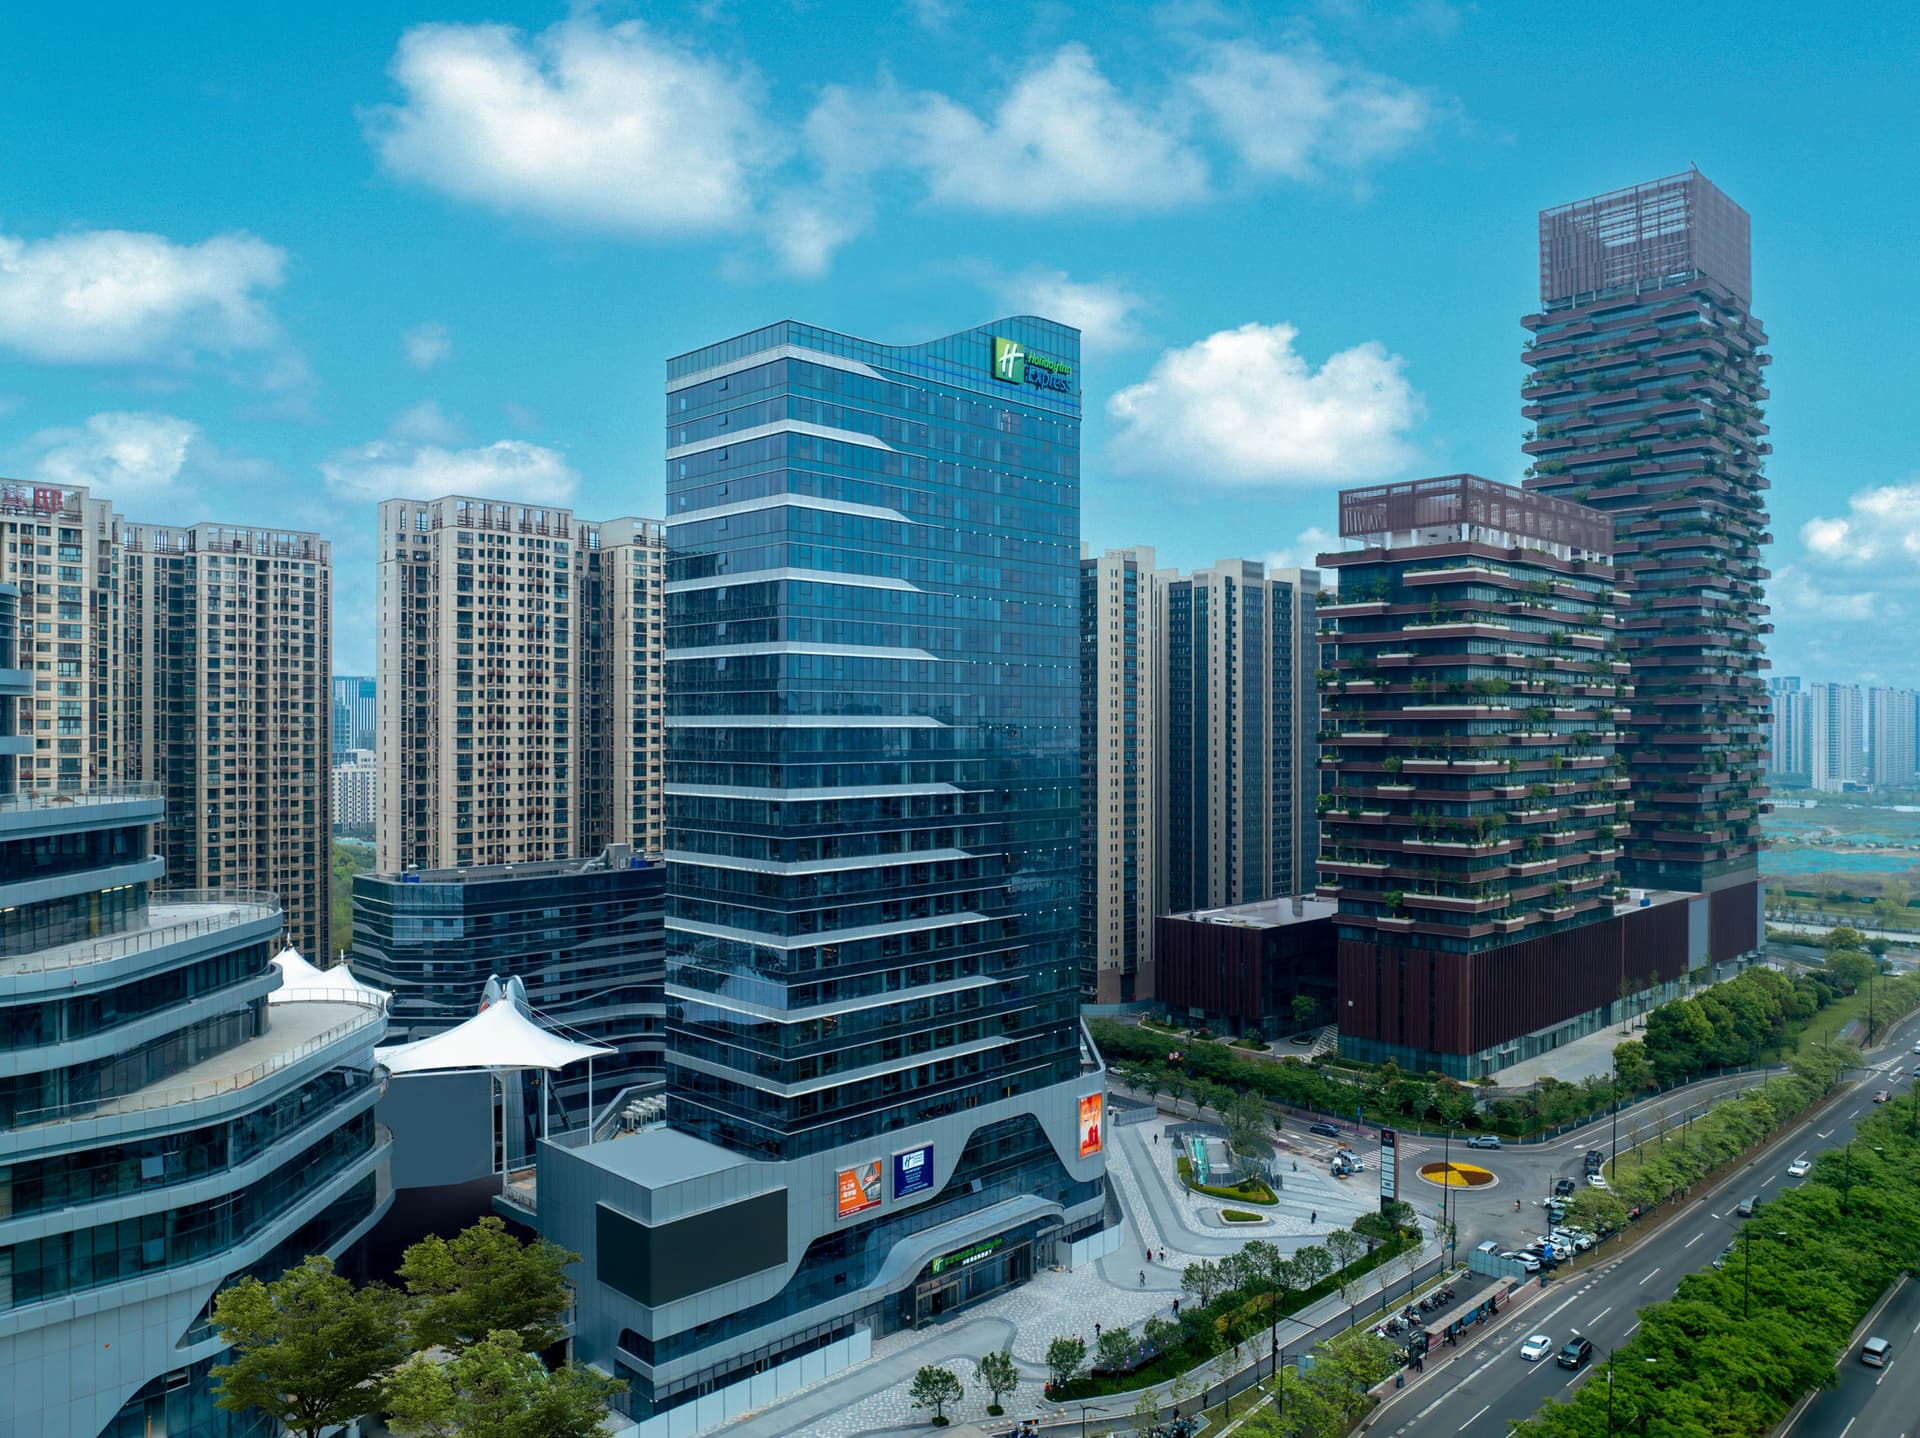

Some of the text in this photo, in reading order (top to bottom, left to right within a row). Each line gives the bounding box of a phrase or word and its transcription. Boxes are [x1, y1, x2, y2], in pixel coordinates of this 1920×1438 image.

[1027, 351, 1072, 375] Holiday Inn
[1028, 366, 1072, 391] Express
